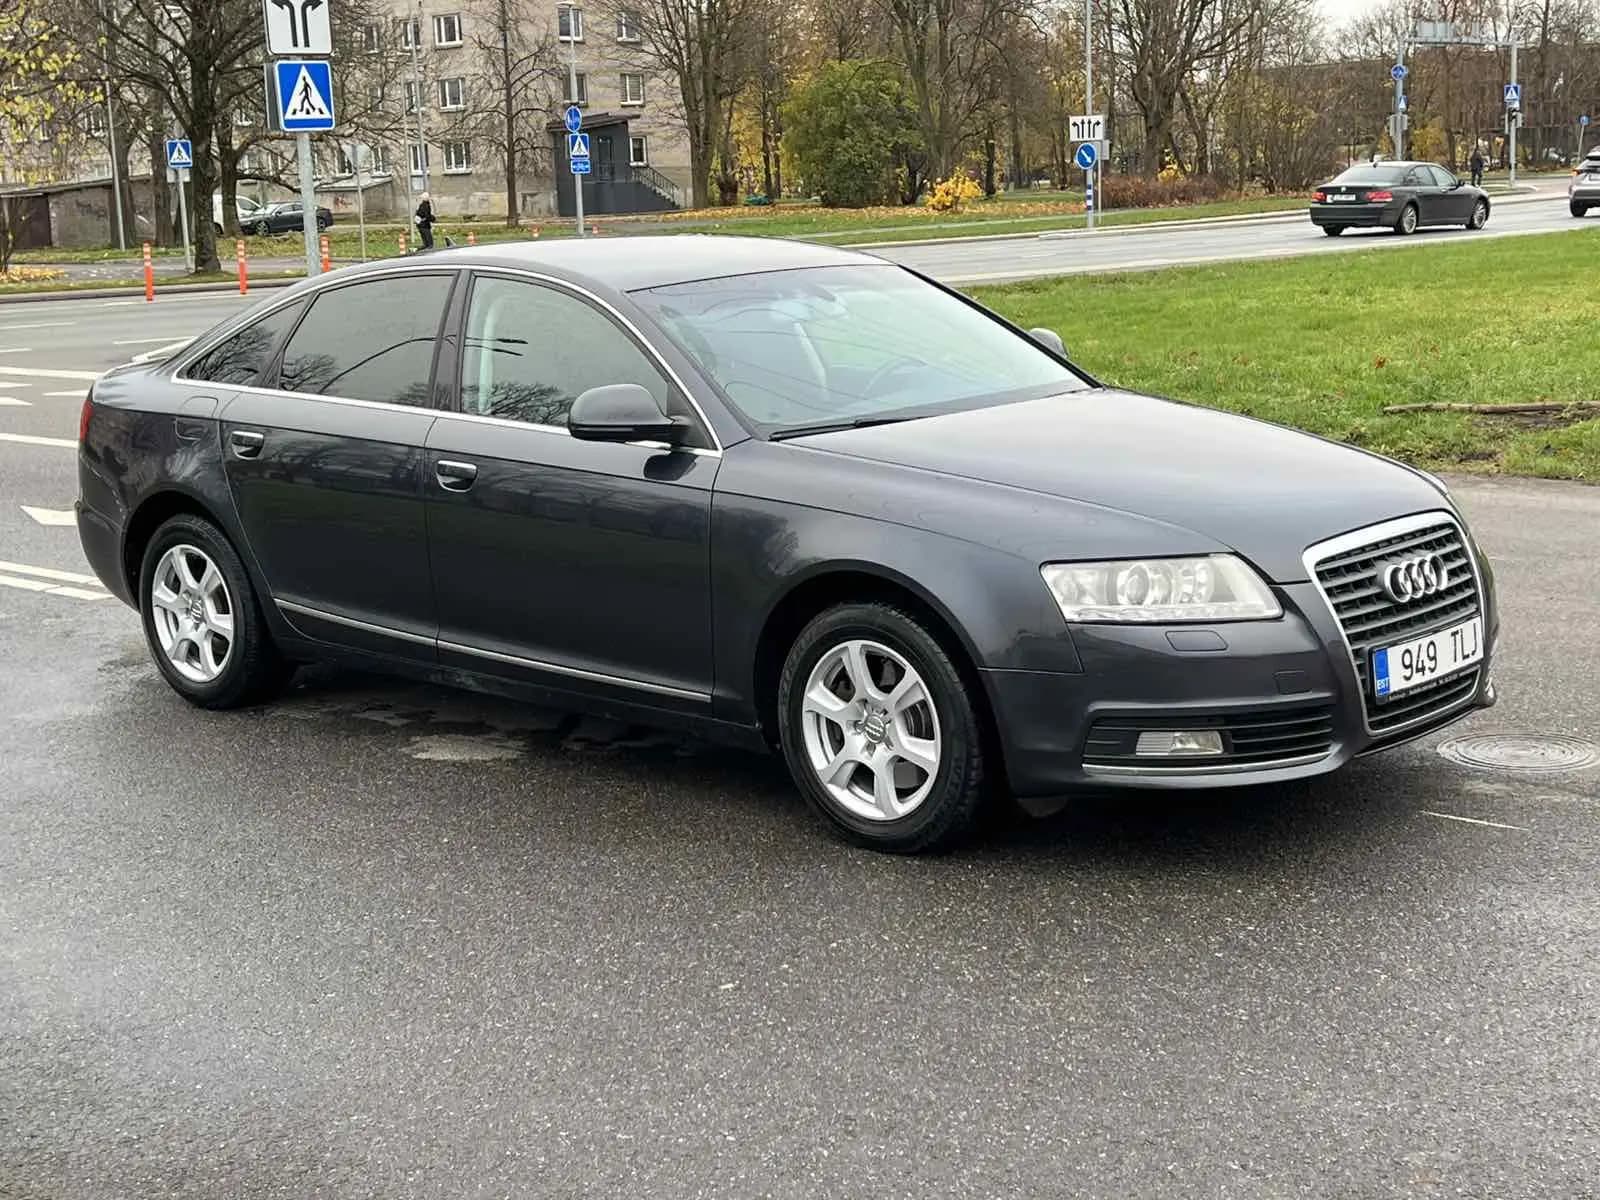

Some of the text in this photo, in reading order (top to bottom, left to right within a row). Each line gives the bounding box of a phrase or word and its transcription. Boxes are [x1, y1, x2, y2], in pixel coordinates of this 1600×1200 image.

[1401, 622, 1478, 681] 949 TLJ
[1376, 678, 1389, 690] EST
